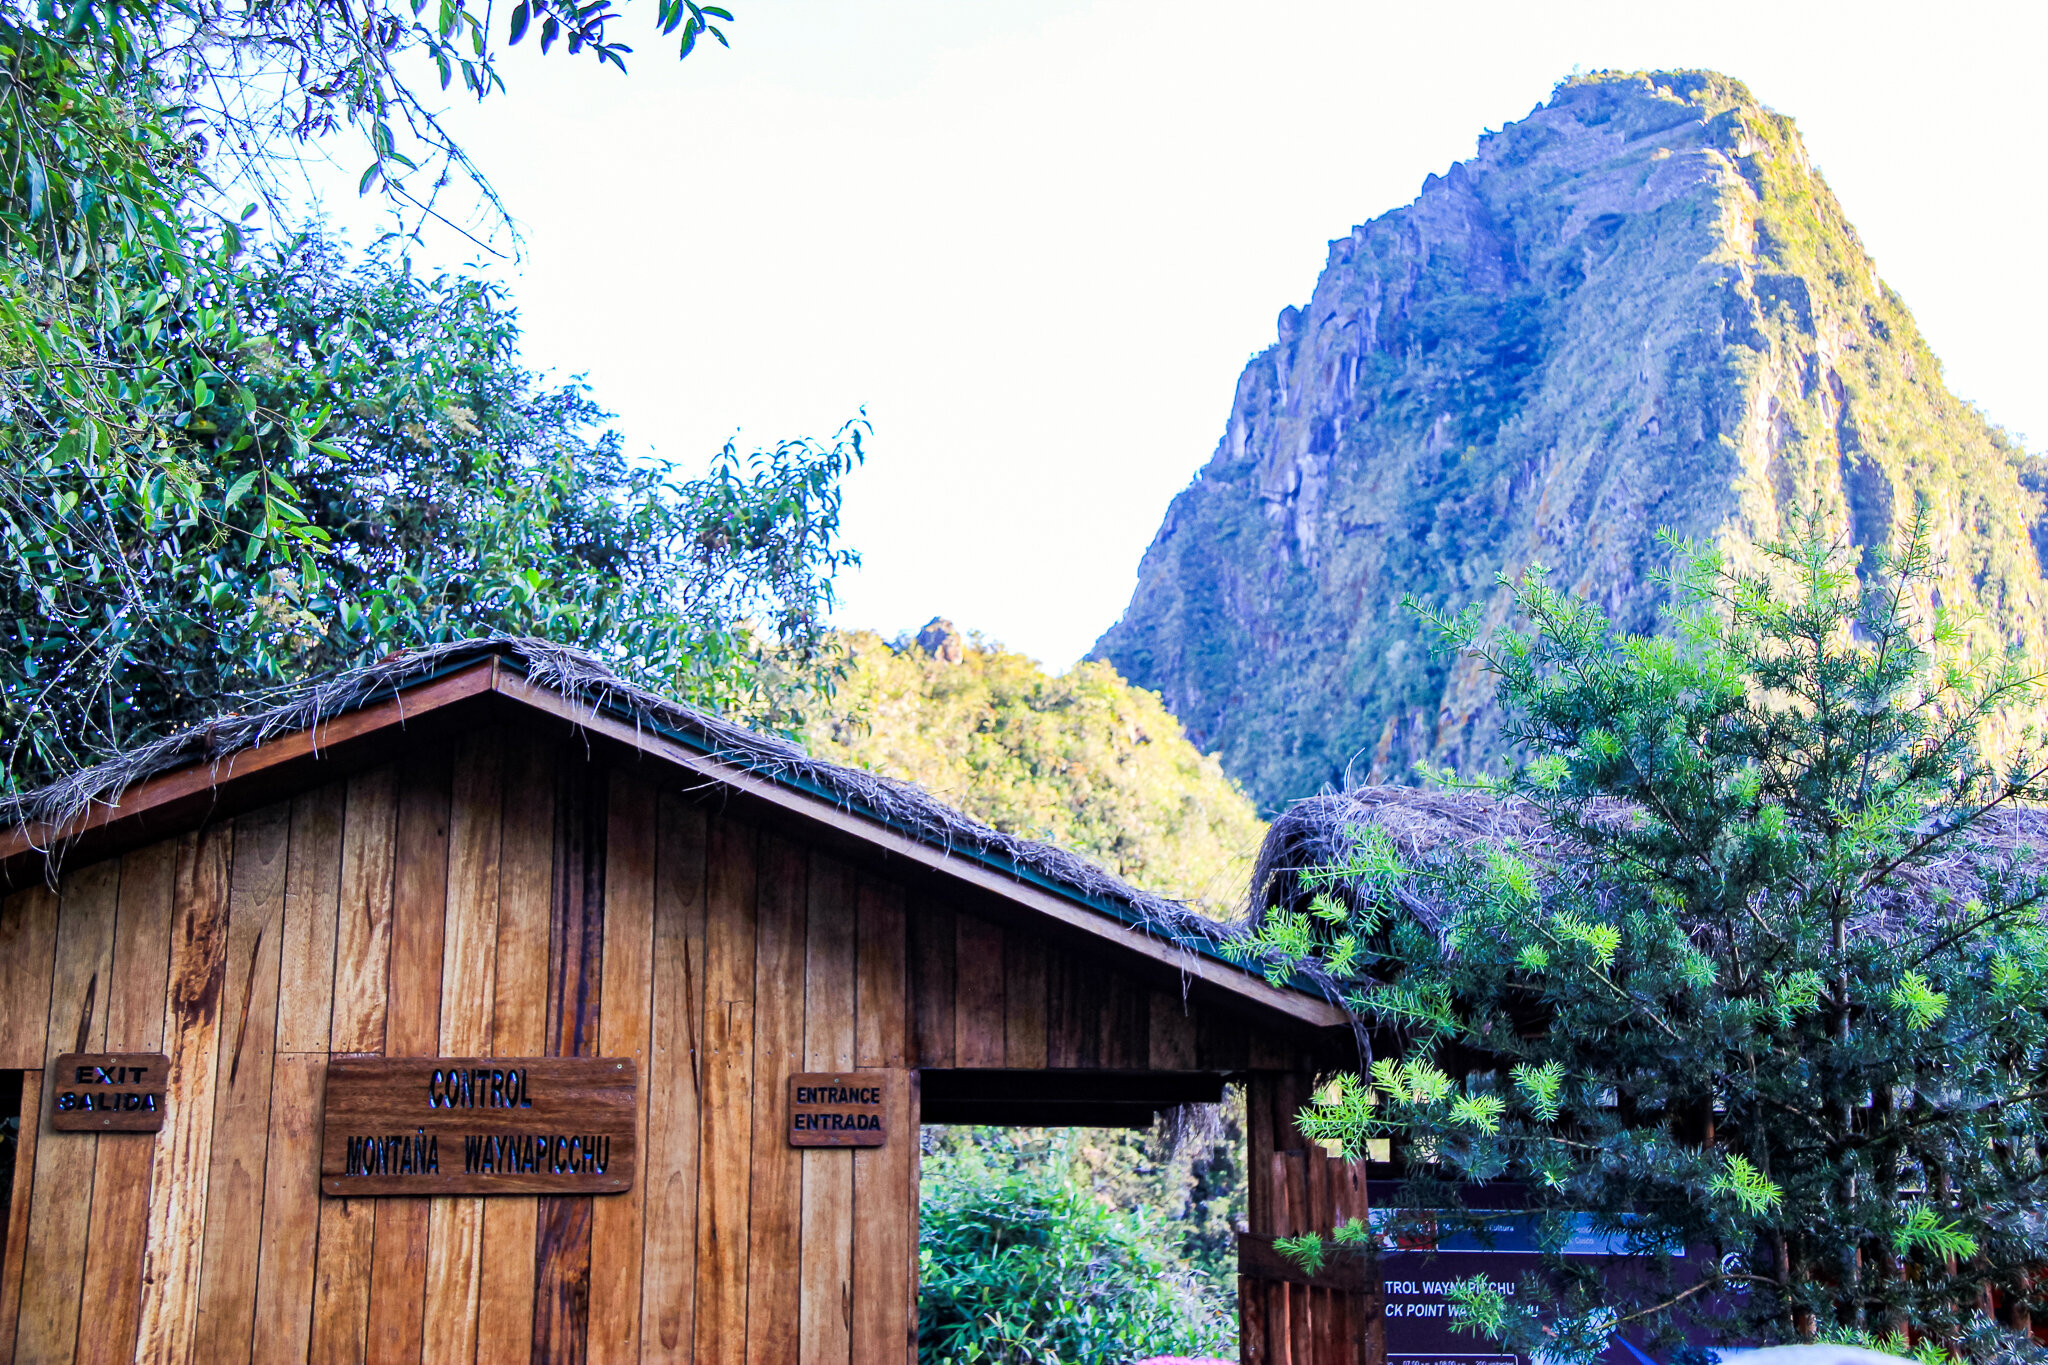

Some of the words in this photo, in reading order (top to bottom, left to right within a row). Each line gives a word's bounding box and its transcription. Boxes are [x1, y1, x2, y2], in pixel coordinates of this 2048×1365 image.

[75, 1066, 148, 1085] EXIT
[428, 1068, 532, 1109] CONTROL
[796, 1086, 880, 1105] ENTRANCE
[58, 1091, 157, 1112] SALIDA
[794, 1113, 881, 1131] ENTRADA
[345, 1126, 440, 1177] MONTAÑA
[464, 1134, 610, 1175] WAYNAPICCHU
[1406, 1303, 1445, 1317] POINT
